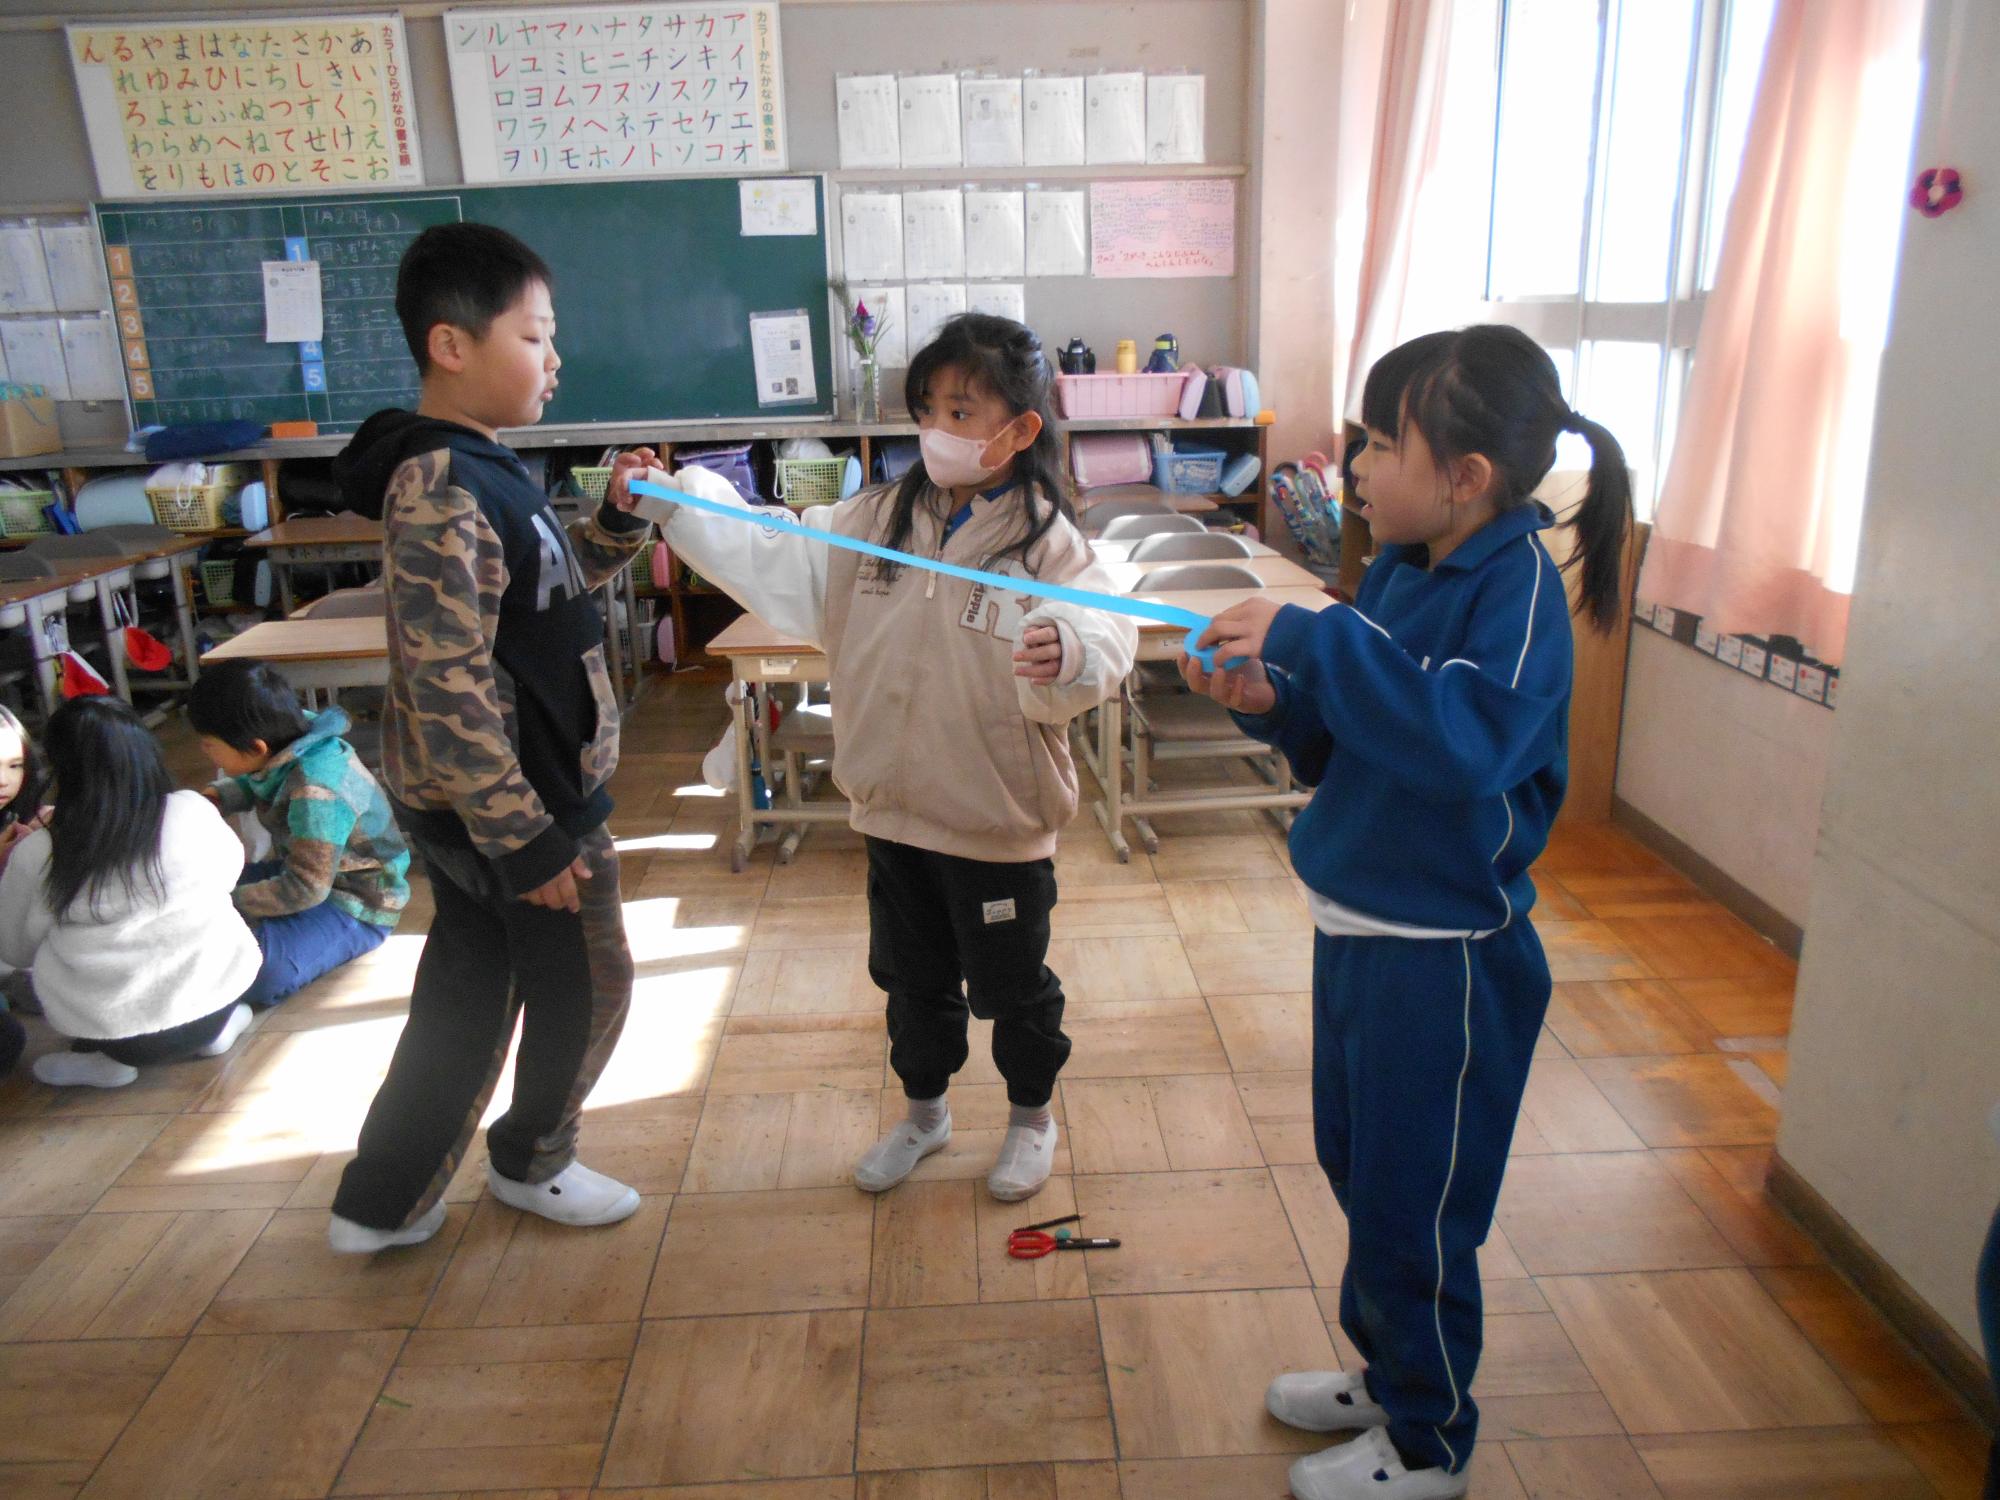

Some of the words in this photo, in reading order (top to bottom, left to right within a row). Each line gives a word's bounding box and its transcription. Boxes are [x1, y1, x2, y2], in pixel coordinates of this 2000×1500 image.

[458, 24, 478, 46] ン
[83, 37, 104, 64] ん
[113, 254, 123, 271] 1
[118, 284, 133, 303] 2
[125, 318, 139, 334] 3
[129, 348, 144, 364] 4
[308, 368, 321, 387] 5
[135, 379, 149, 395] 5
